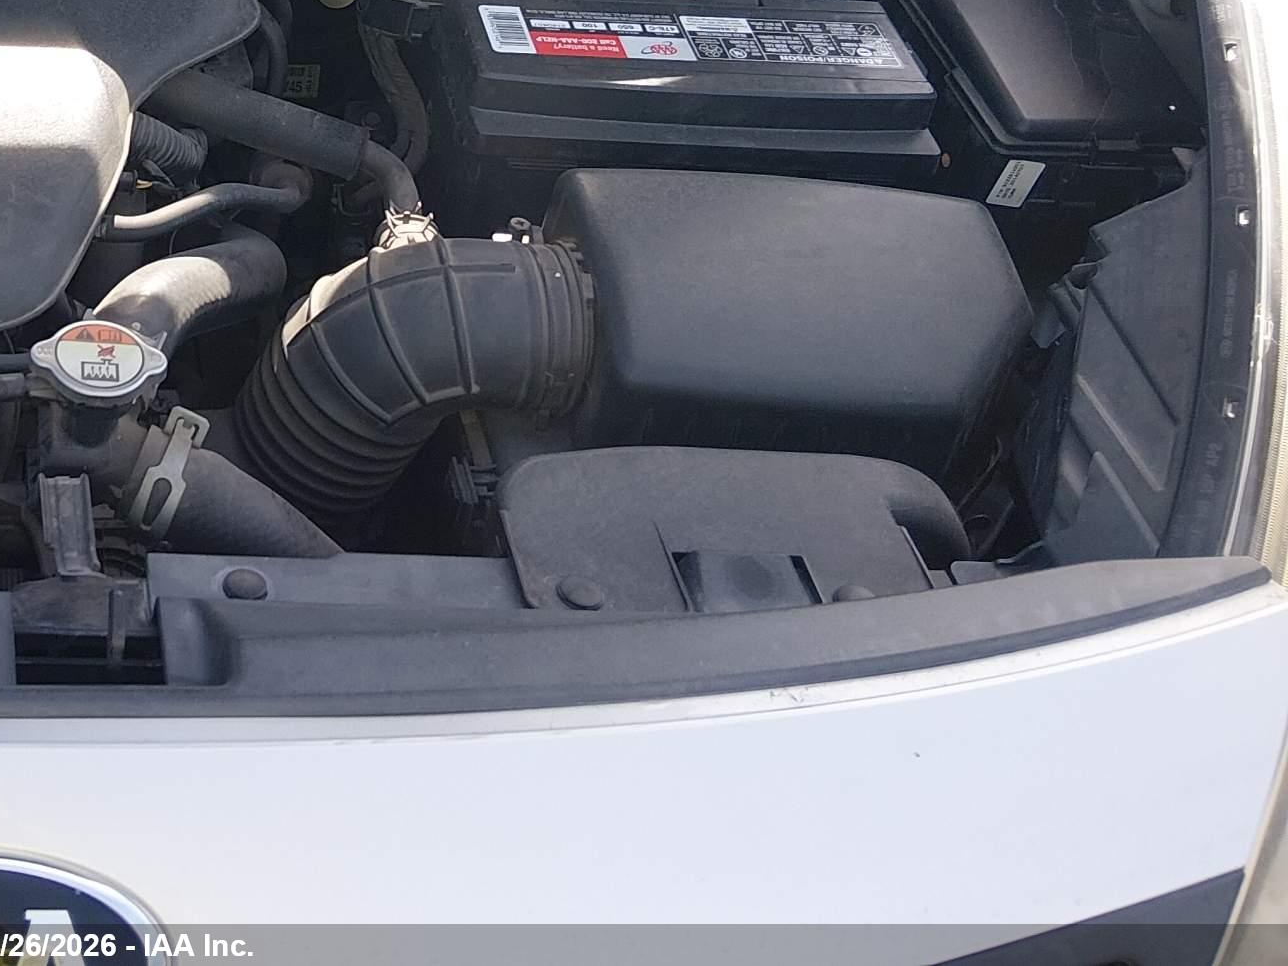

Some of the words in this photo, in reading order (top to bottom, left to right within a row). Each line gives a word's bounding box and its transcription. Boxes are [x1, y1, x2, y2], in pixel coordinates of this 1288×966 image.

[553, 42, 589, 52] battery?
[598, 45, 620, 53] Need
[779, 54, 874, 65] DANGER/POISON
